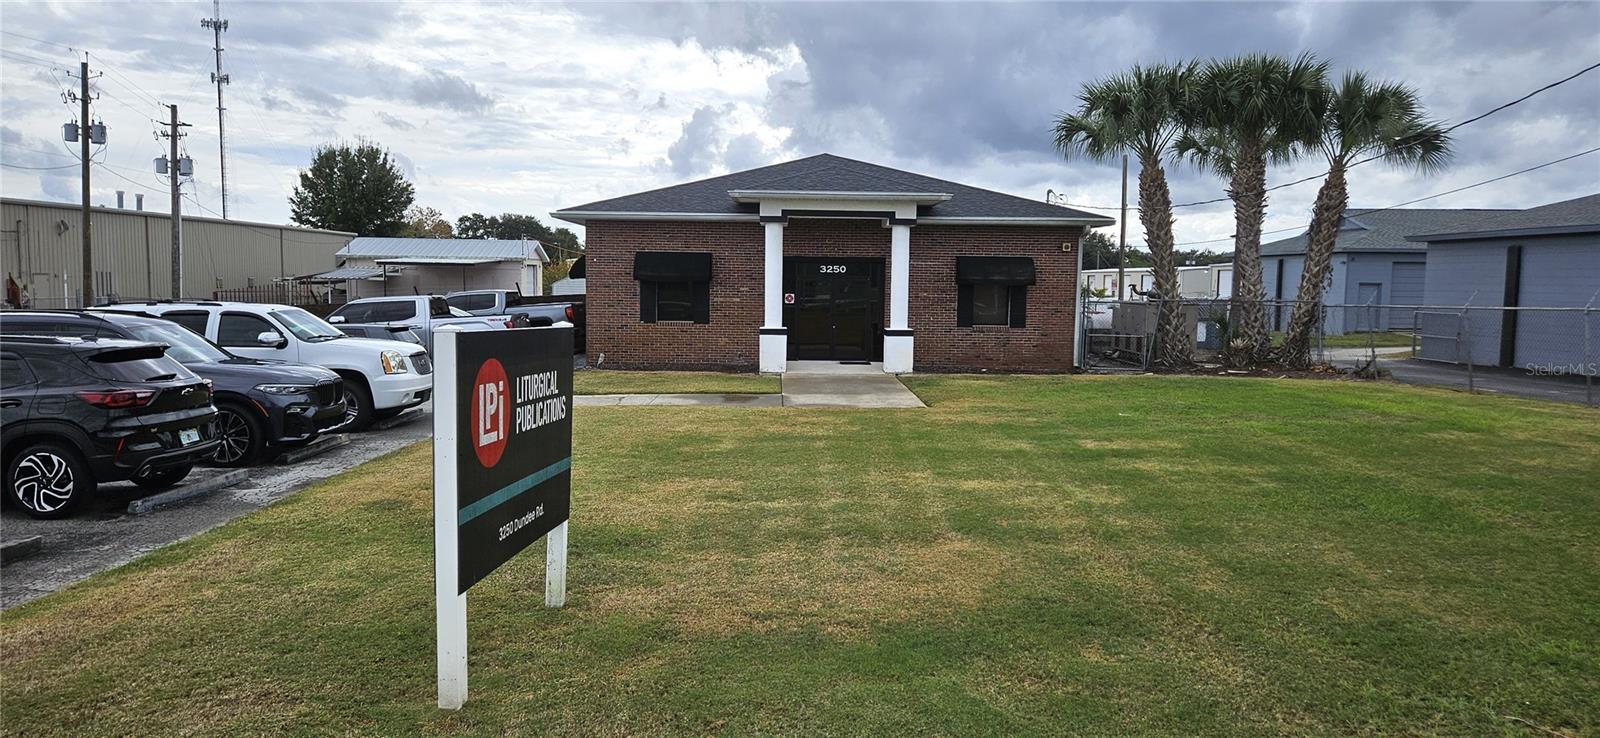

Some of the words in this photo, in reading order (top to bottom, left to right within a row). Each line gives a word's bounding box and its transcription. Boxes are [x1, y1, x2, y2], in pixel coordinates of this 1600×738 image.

[820, 265, 847, 273] 3250
[516, 370, 559, 404] LITURGICAL
[516, 395, 566, 434] PUBLICATIONS
[499, 520, 514, 541] 3250
[514, 510, 536, 532] Dundee
